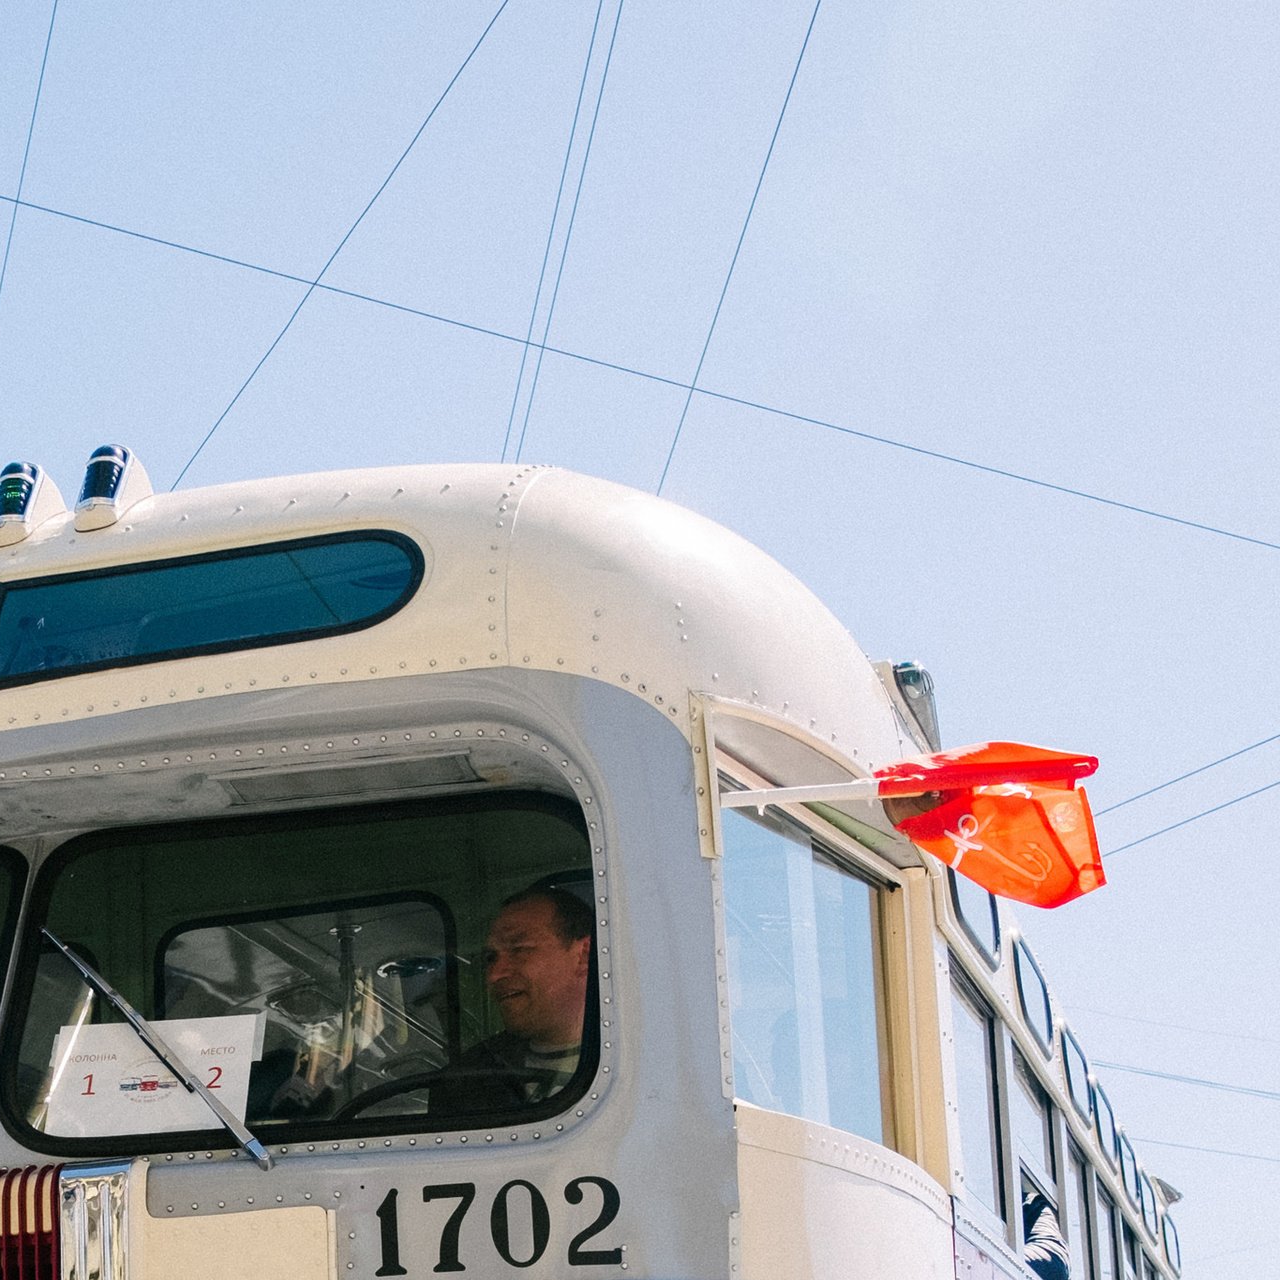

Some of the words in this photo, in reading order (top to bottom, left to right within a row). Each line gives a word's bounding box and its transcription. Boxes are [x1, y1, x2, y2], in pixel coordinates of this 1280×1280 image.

[200, 1046, 236, 1056] МЕСТО
[81, 1073, 96, 1095] 1
[205, 1066, 223, 1089] 2
[375, 1175, 623, 1278] 1702
